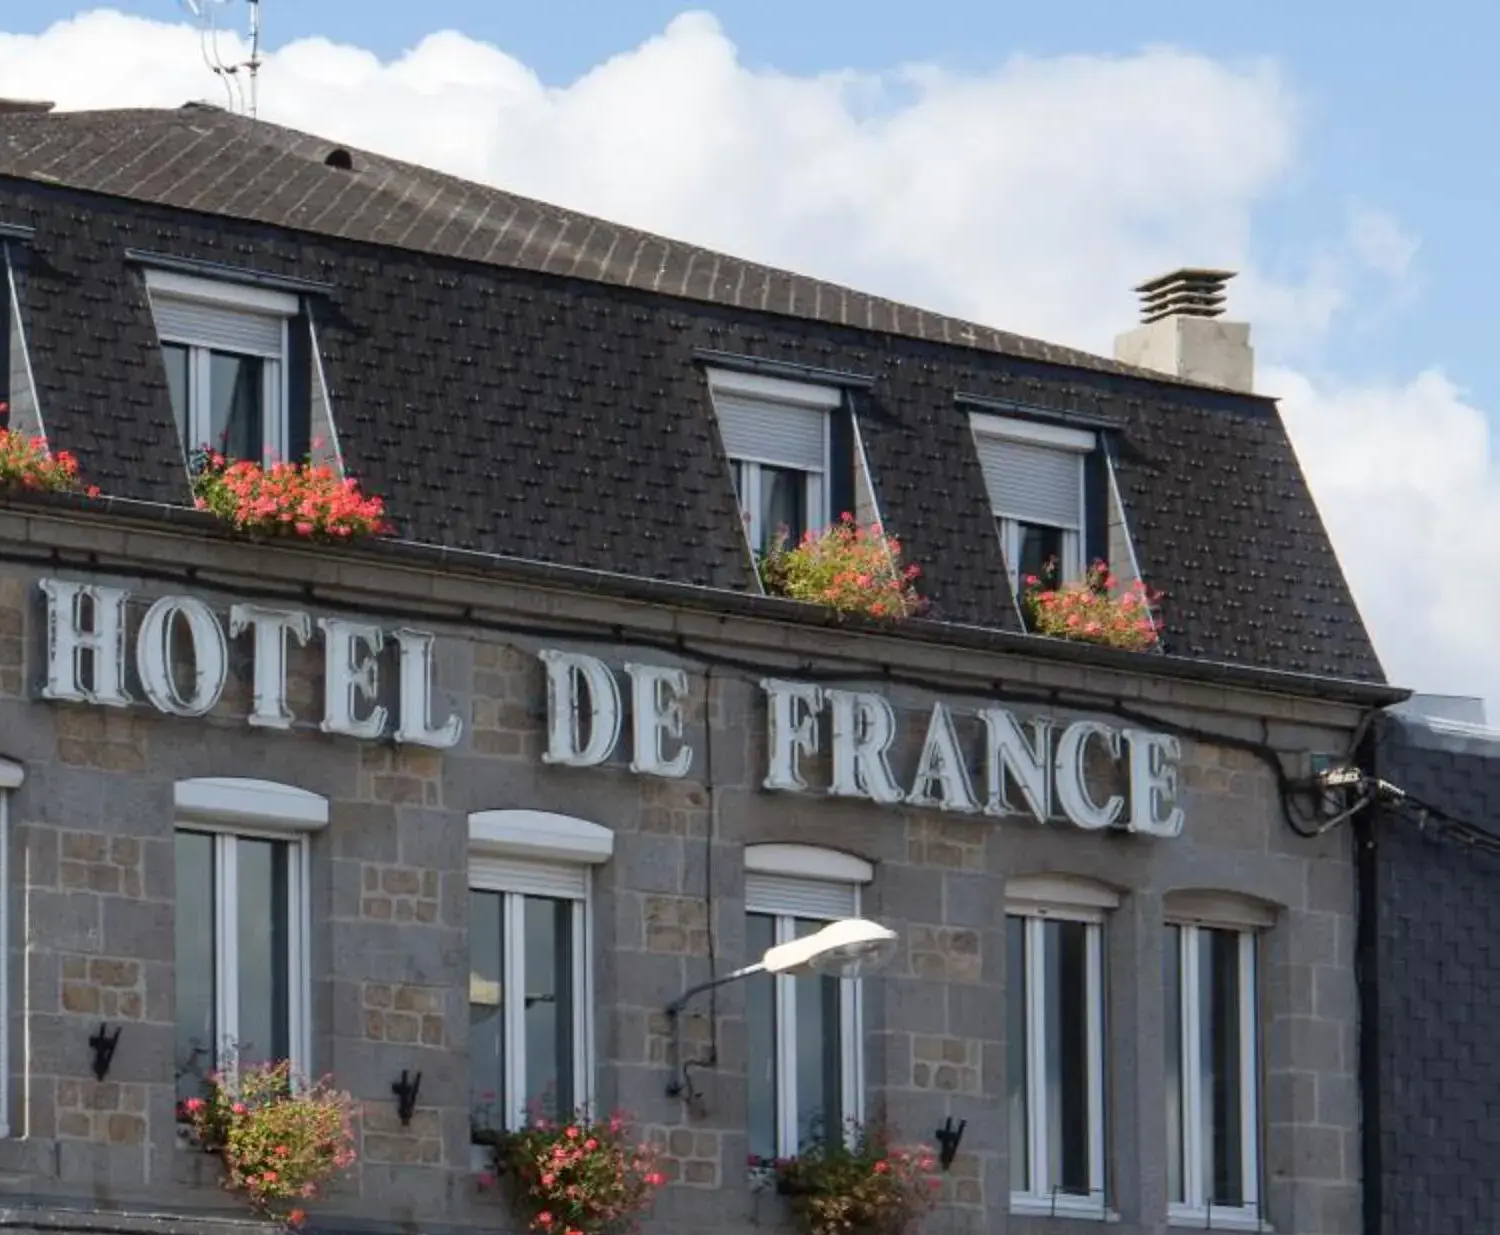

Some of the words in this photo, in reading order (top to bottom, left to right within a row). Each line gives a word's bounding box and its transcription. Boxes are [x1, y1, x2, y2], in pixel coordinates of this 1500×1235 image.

[38, 577, 463, 748] HOTEL
[539, 649, 693, 778] DE
[759, 677, 1185, 837] FRANCE
